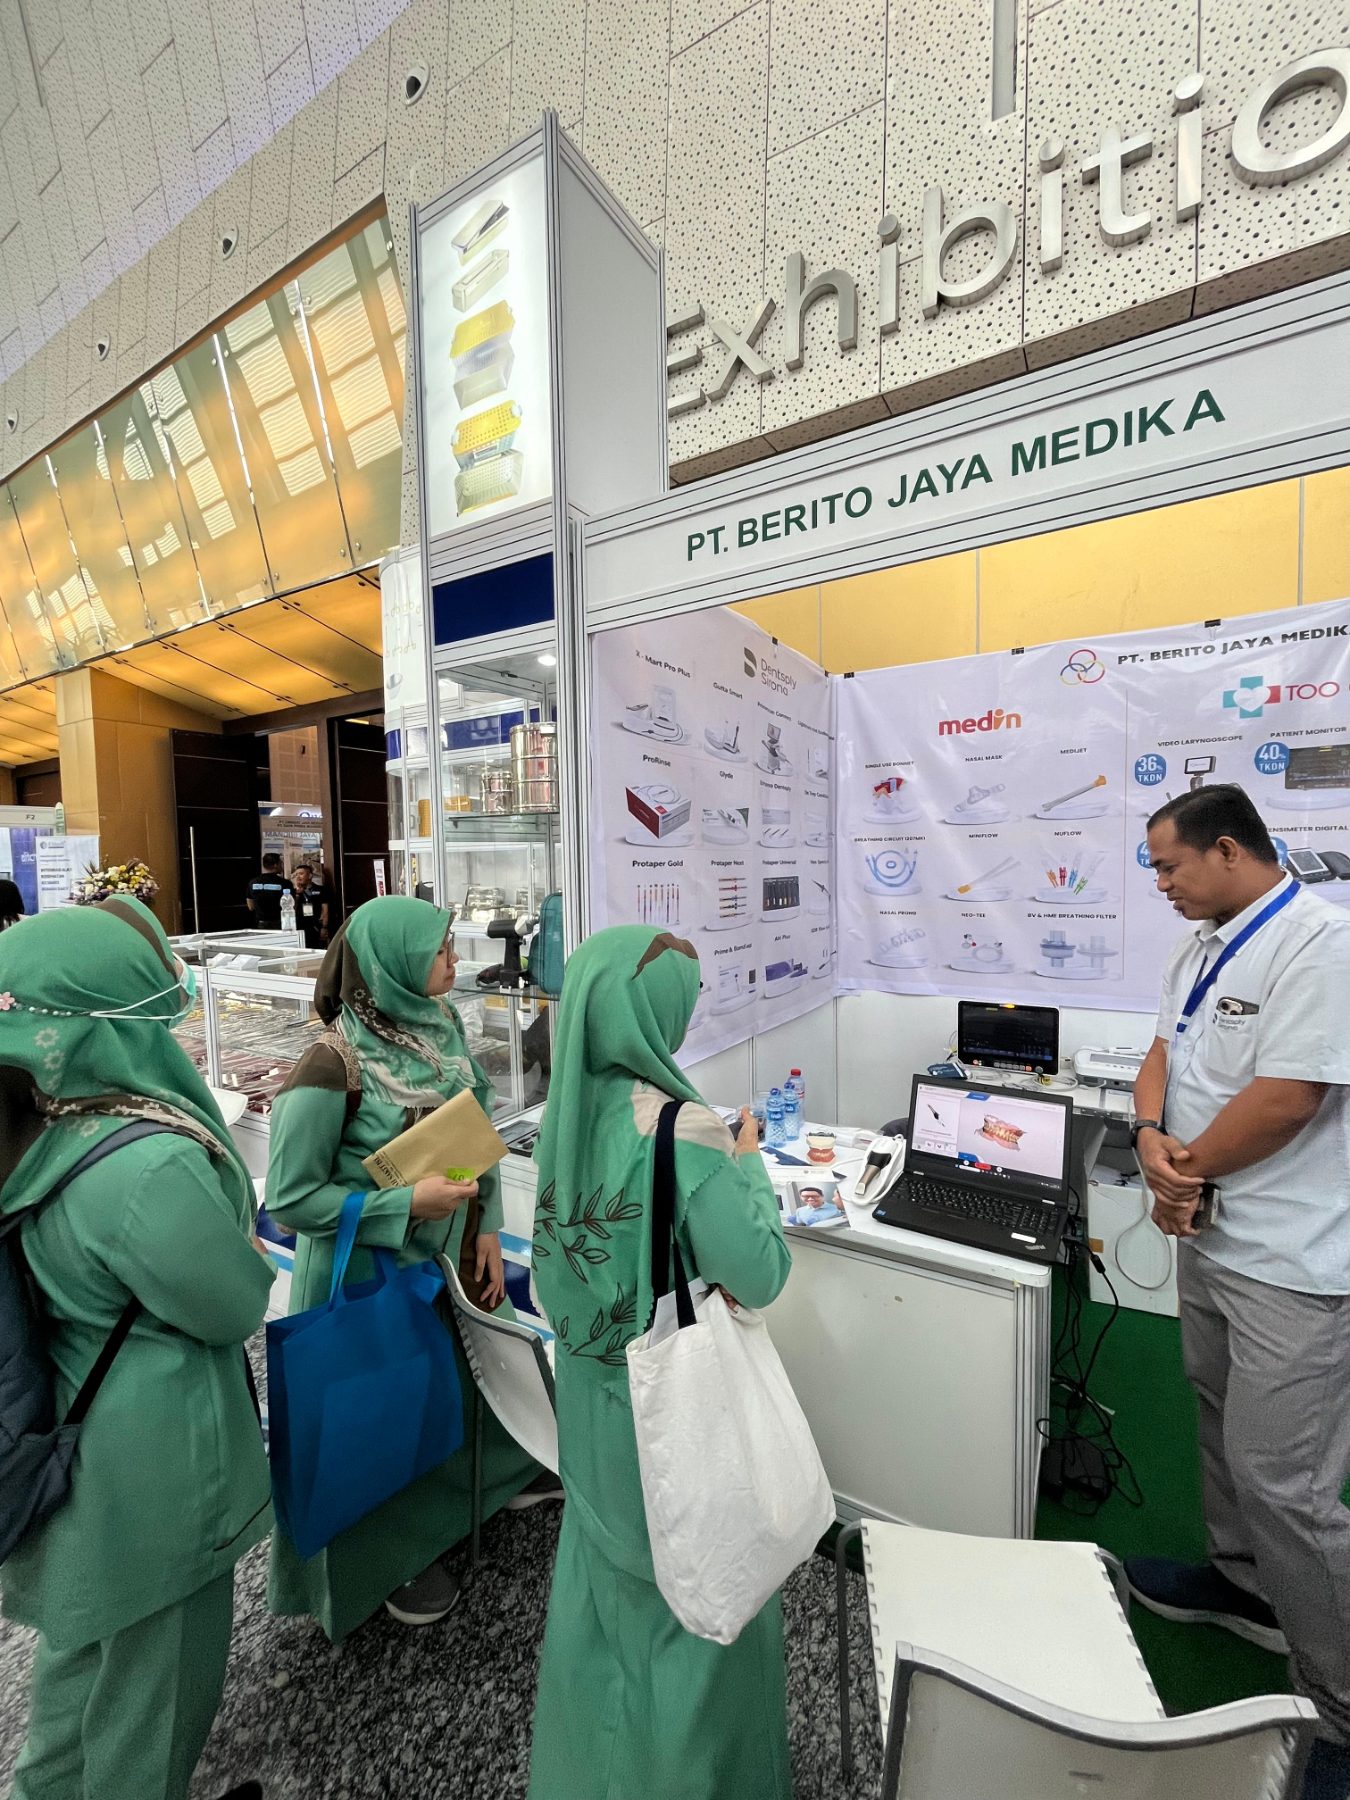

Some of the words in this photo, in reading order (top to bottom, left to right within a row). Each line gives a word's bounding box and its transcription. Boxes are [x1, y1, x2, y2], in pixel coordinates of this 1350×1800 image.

[687, 526, 729, 561] PT.
[736, 487, 873, 549] BERITO
[886, 453, 993, 509] JAYA
[1010, 388, 1226, 477] MEDIKA
[1117, 653, 1144, 664] PT.
[1150, 644, 1216, 661] BERITO
[1220, 636, 1274, 655] JAYA
[1281, 624, 1350, 643] MEDIK
[664, 662, 676, 672] Pro
[677, 667, 691, 678] Plus
[760, 658, 797, 690] Dentsply
[761, 672, 789, 696] Sirona
[938, 708, 1022, 737] medin
[1270, 730, 1304, 738] PATIENT
[1305, 726, 1347, 736] MONITOR
[1181, 735, 1243, 745] LARYNGOSCOPE
[643, 754, 671, 767] ProRinse
[632, 860, 666, 869] Protaper
